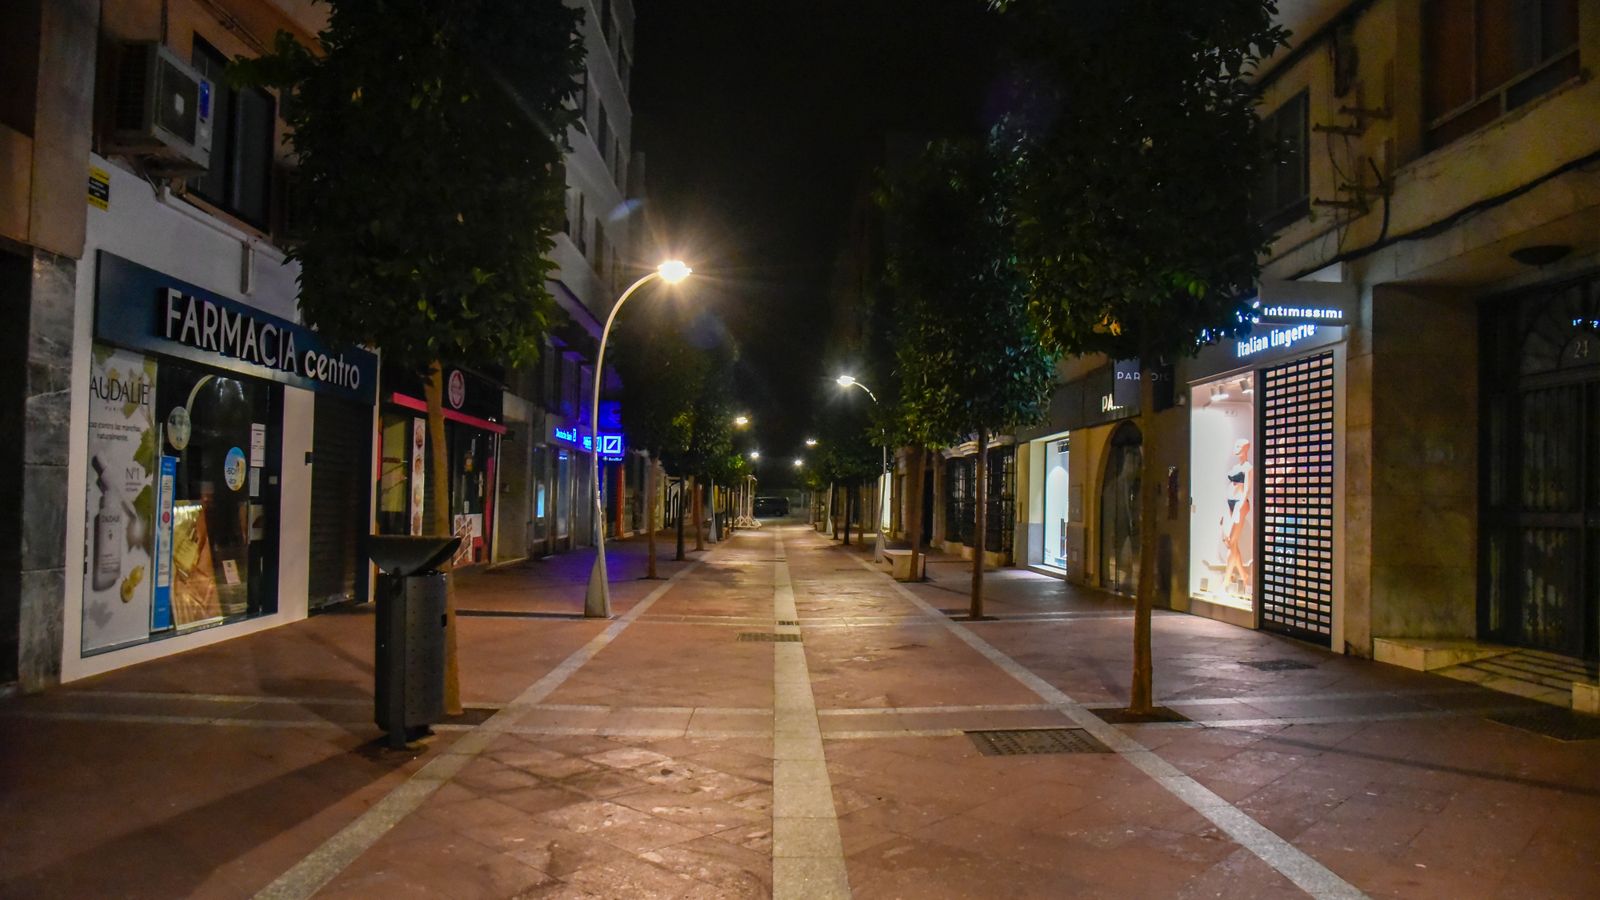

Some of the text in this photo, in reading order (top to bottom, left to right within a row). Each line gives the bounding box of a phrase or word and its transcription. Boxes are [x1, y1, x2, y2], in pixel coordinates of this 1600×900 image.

[1263, 305, 1343, 319] intimissimi
[166, 287, 360, 390] FARMACIA centro
[1237, 336, 1269, 358] Italian
[1271, 324, 1315, 348] lingerie
